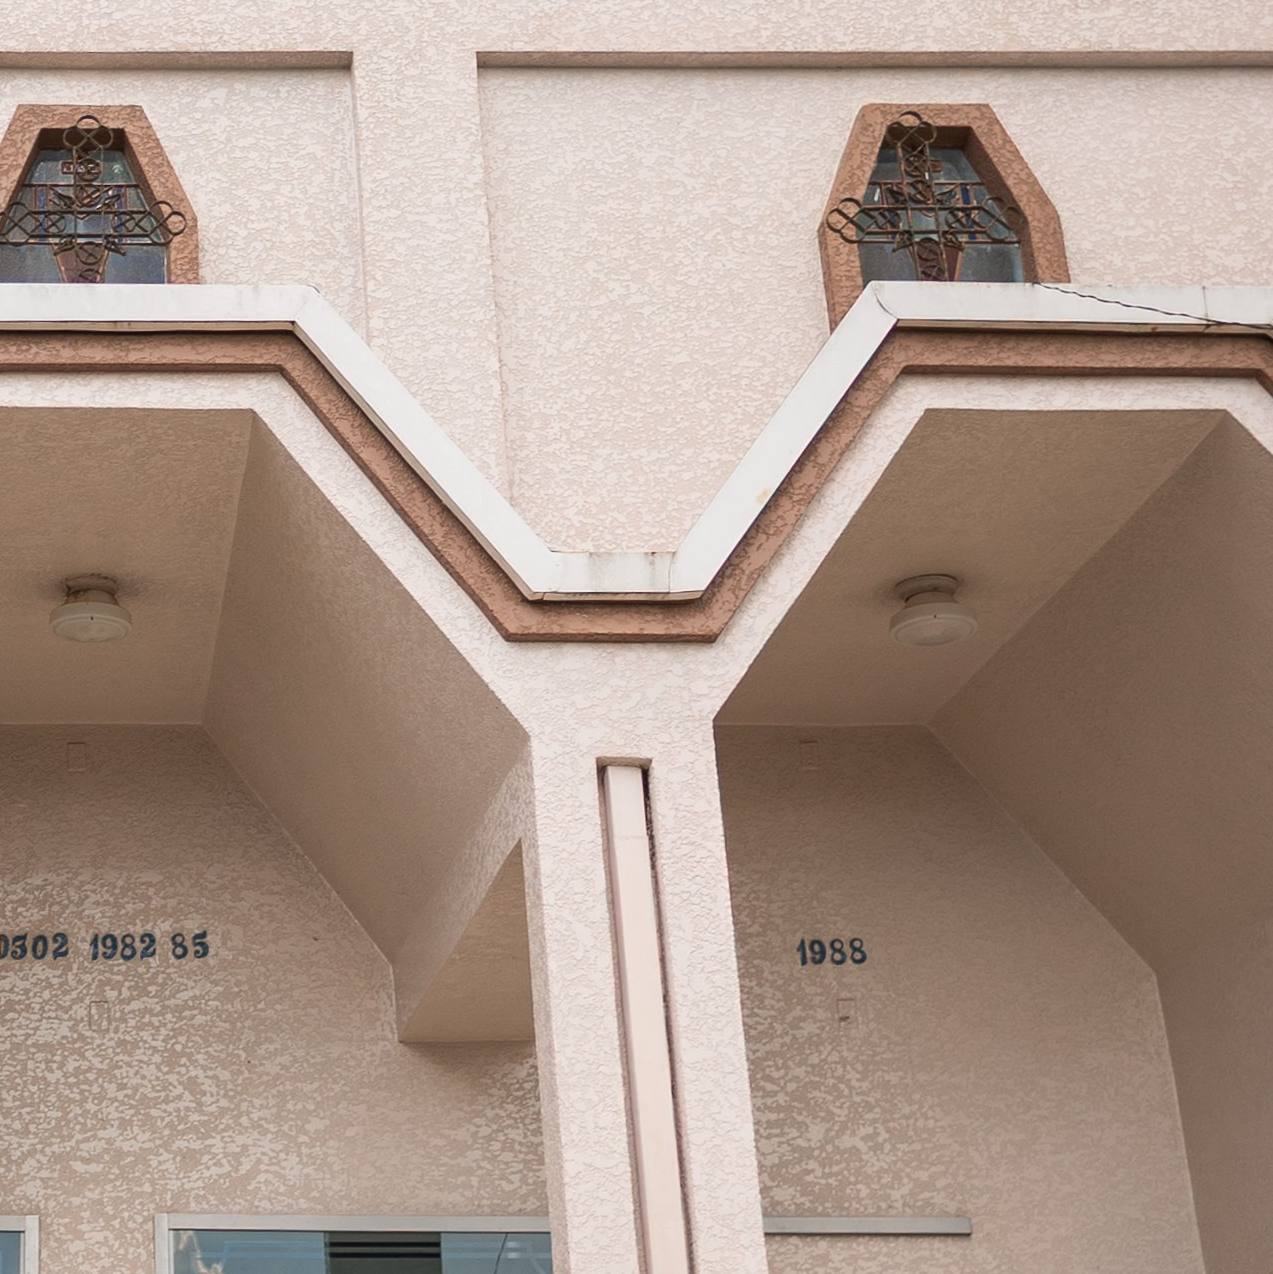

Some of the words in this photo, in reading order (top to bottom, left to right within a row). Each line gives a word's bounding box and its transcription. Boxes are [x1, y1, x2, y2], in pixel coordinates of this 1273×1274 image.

[90, 933, 157, 961] 1982
[171, 930, 209, 959] 85
[796, 938, 867, 966] 1988
